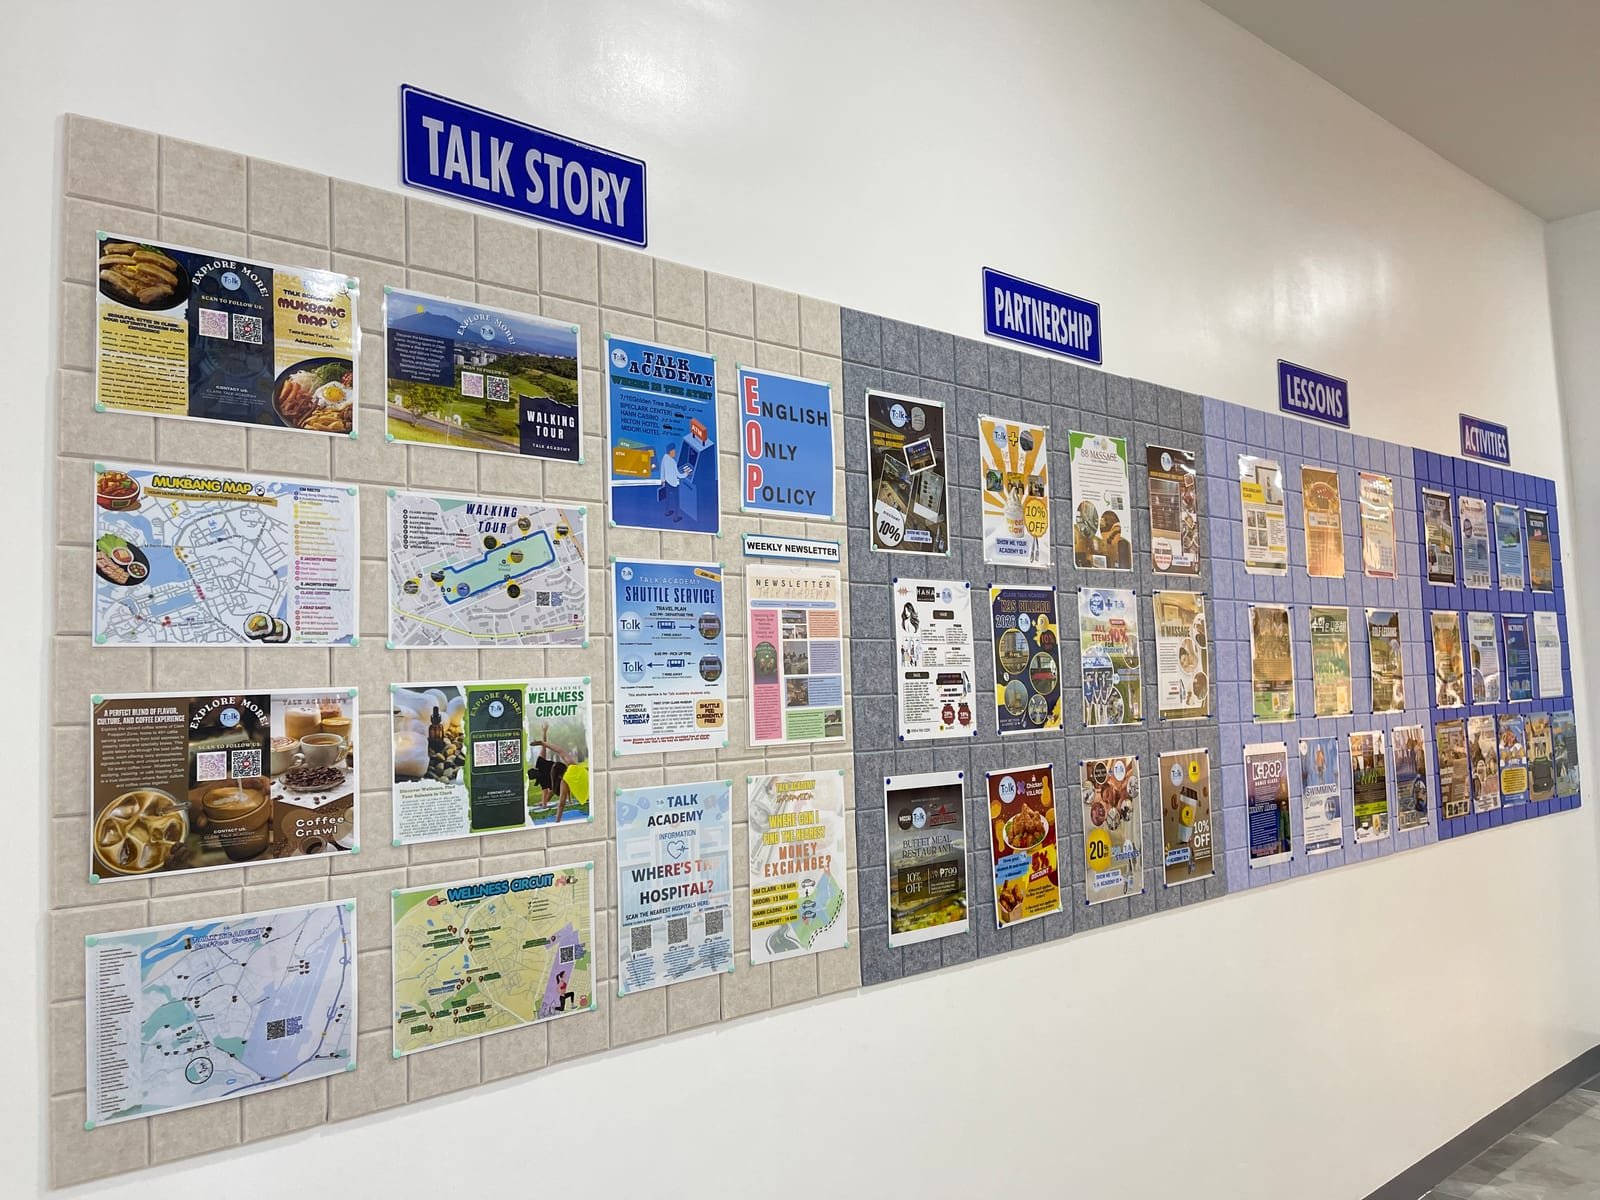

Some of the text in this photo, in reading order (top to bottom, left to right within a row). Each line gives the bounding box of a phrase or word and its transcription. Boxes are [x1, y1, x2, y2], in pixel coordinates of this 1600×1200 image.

[422, 115, 631, 228] TALK STORY
[192, 261, 269, 297] EXPLORE MORE!
[223, 275, 240, 285] Talk
[228, 300, 253, 308] FOLLOW
[278, 297, 346, 318] MUKBANG
[297, 314, 328, 327] MAP
[994, 286, 1092, 351] PARTNERSHIP
[457, 314, 516, 345] EXPLORE MORE!
[643, 352, 690, 371] TALK
[629, 361, 713, 387] ACADEMY
[744, 376, 828, 427] ENGLISH
[1287, 374, 1343, 418] LESSONS
[527, 410, 575, 428] WALKING
[637, 412, 659, 421] CASINO
[892, 410, 904, 419] Talk
[641, 420, 660, 428] HOTEL
[642, 427, 660, 435] HOTEL
[691, 425, 702, 436] ATM
[536, 425, 564, 439] TOUR
[746, 419, 797, 461] ONLY
[1465, 424, 1507, 459] ACTIVITIES
[1090, 450, 1118, 462] MASSAGE
[152, 475, 253, 494] MUKBANG MAP
[747, 463, 816, 506] POLICY
[466, 504, 517, 518] WALKING
[1026, 506, 1046, 518] 10%
[478, 521, 507, 534] TOUR
[879, 520, 901, 542] 10%
[1029, 521, 1045, 533] OFF
[747, 541, 837, 556] WEEKLY NEWSLETTER
[663, 577, 701, 585] ACADEMY
[756, 578, 831, 589] NEWSLETTER
[625, 586, 716, 604] SHUTTLE SERVICE
[620, 619, 641, 631] Talk
[1166, 626, 1190, 637] MASSAGE
[623, 661, 643, 672] Talk
[470, 692, 522, 717] EXPLORE MORE!
[528, 690, 584, 705] WELLNESS
[190, 697, 269, 730] EXPLORE MORE!
[222, 713, 238, 721] Talk
[535, 704, 578, 718] CIRCUIT
[1253, 761, 1281, 780] K-POP
[1001, 783, 1014, 792] Talk
[1306, 784, 1336, 796] SWIMMING
[667, 794, 698, 808] TALK
[296, 816, 344, 827] Coffee
[648, 810, 703, 827] ACADEMY
[769, 813, 797, 829] WHERE
[799, 811, 814, 825] CAN
[295, 826, 337, 837] Crawl
[1194, 820, 1209, 834] 10%
[659, 829, 696, 840] INFORMATION
[763, 832, 779, 845] FIND
[781, 830, 794, 843] THE
[1194, 833, 1210, 847] OFF
[903, 835, 951, 849] BUFFET MEAL
[779, 843, 817, 860] MONEY
[632, 860, 692, 883] WHERE'S
[764, 855, 831, 877] EXCHANGE?
[907, 872, 921, 883] 10%
[1031, 868, 1049, 880] DISCOUNT
[447, 874, 554, 902] WELLNESS CIRCUIT
[640, 880, 714, 905] HOSPITAL?
[906, 883, 922, 894] OFF
[650, 908, 670, 916] NEAREST
[672, 903, 696, 911] HOSPITALS
